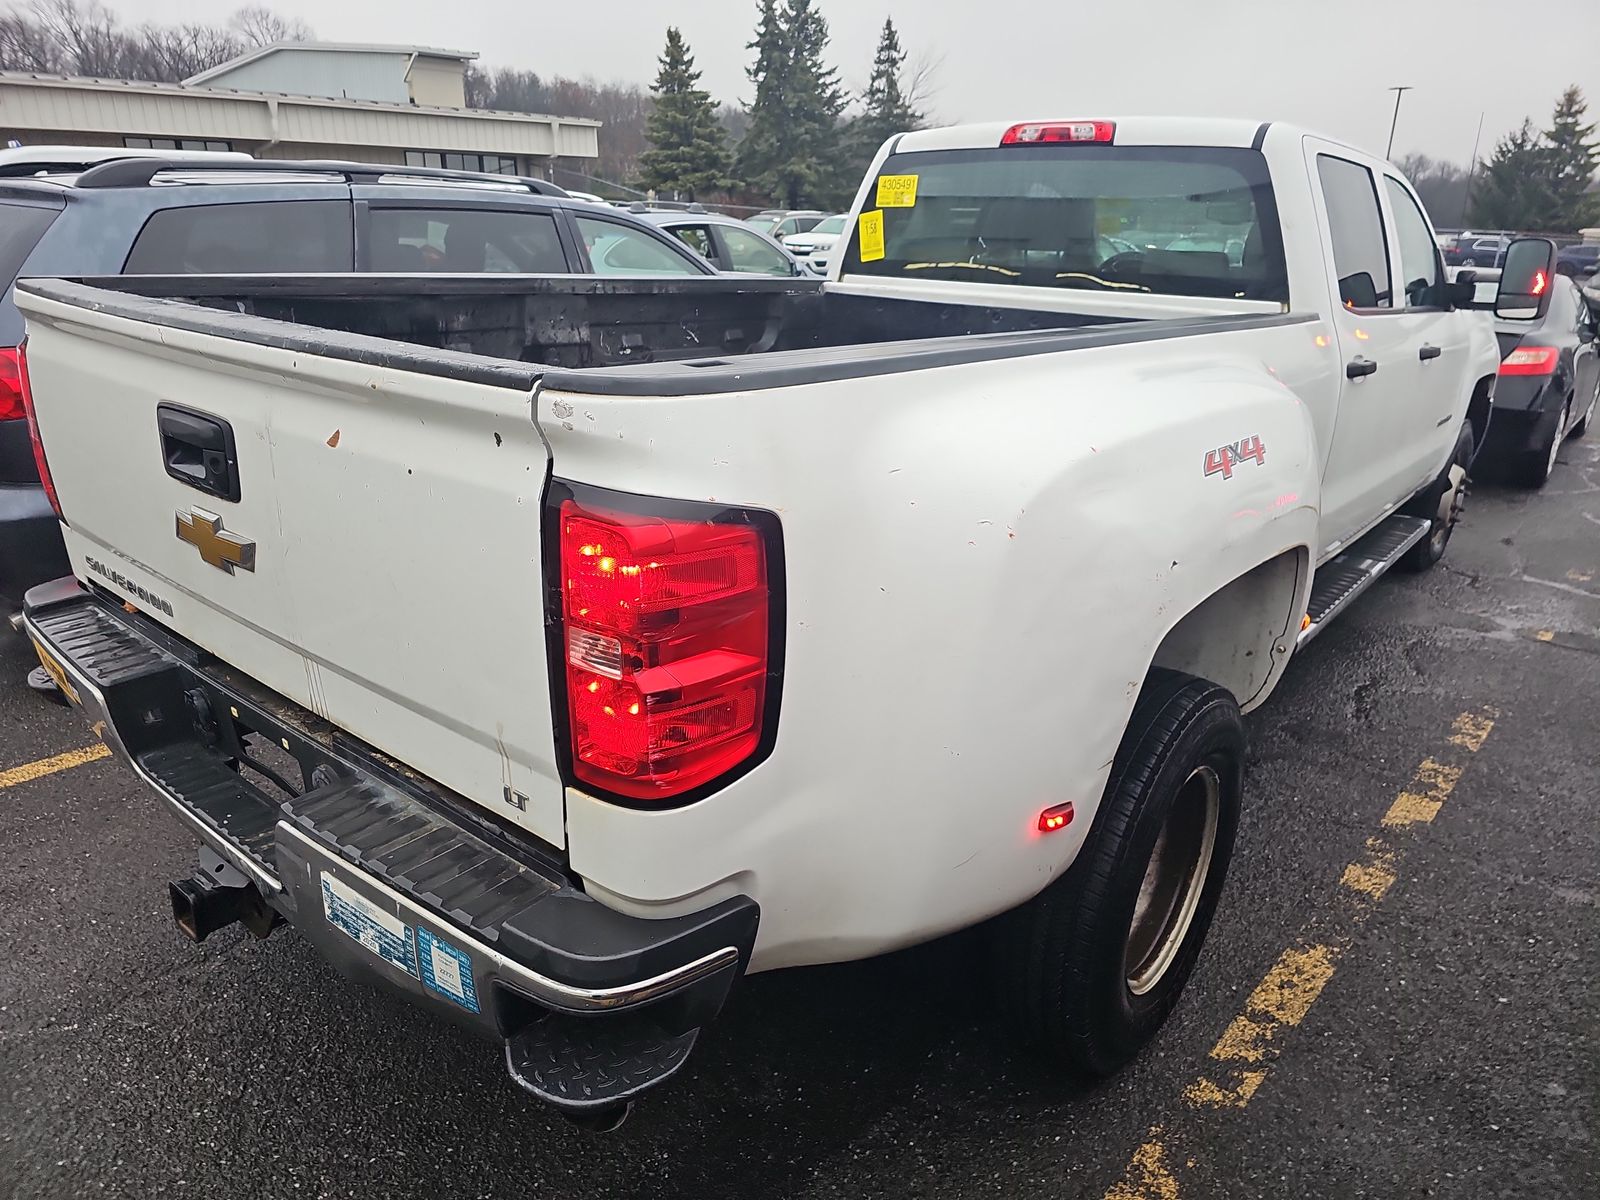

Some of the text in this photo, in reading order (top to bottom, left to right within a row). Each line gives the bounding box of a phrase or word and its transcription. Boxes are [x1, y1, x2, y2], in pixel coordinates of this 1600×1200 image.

[882, 179, 915, 190] 4305491
[84, 555, 174, 617] SILVERADO
[503, 784, 530, 812] LT
